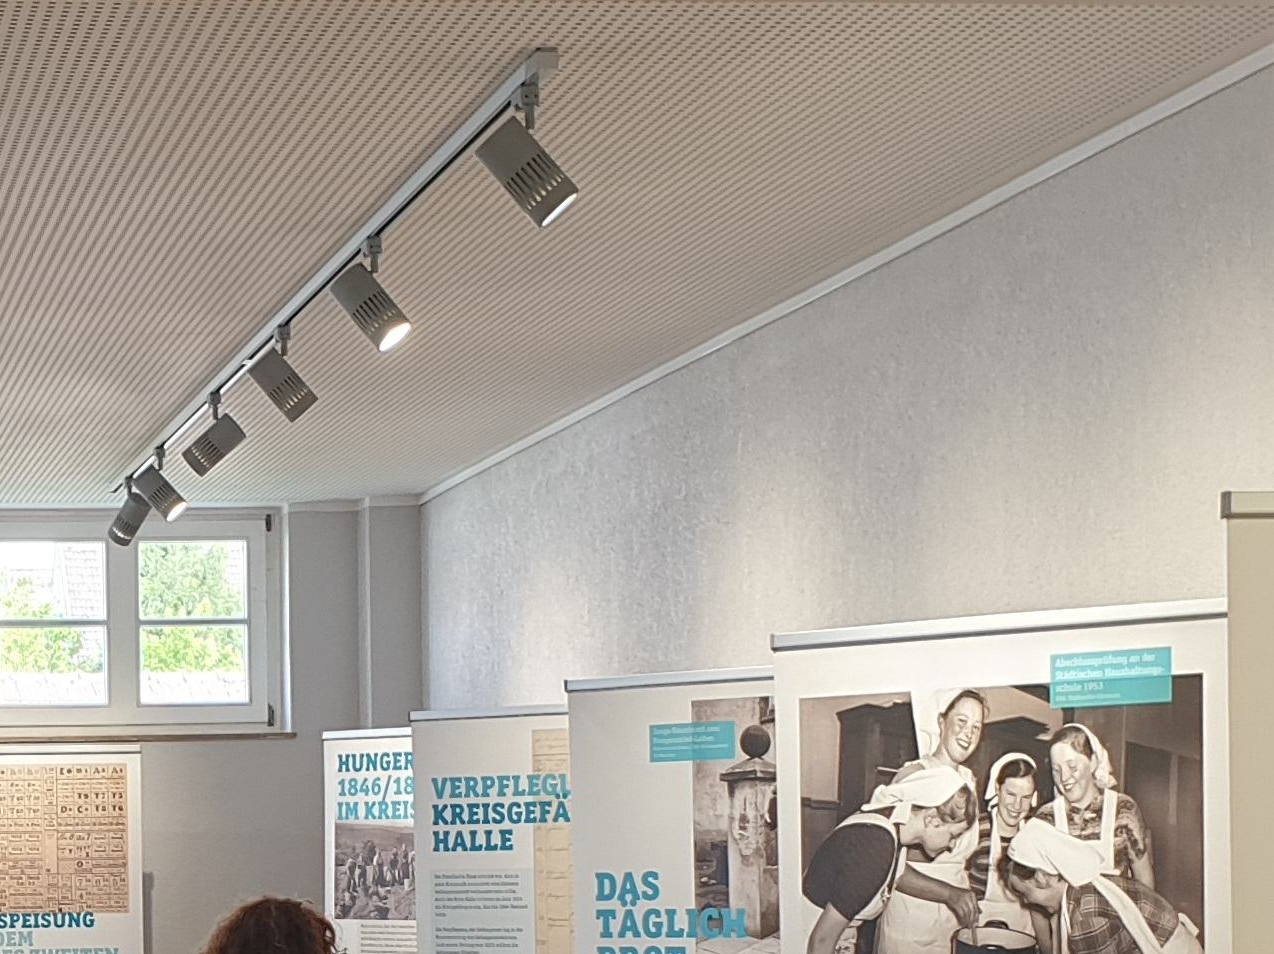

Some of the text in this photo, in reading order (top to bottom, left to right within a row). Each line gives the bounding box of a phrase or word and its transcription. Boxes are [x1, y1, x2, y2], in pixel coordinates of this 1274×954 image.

[338, 803, 359, 820] IM
[432, 793, 571, 825] KREISGEFÄ
[433, 830, 513, 852] HALLE
[595, 871, 659, 901] DAS
[596, 900, 747, 938] TÄGLICH
